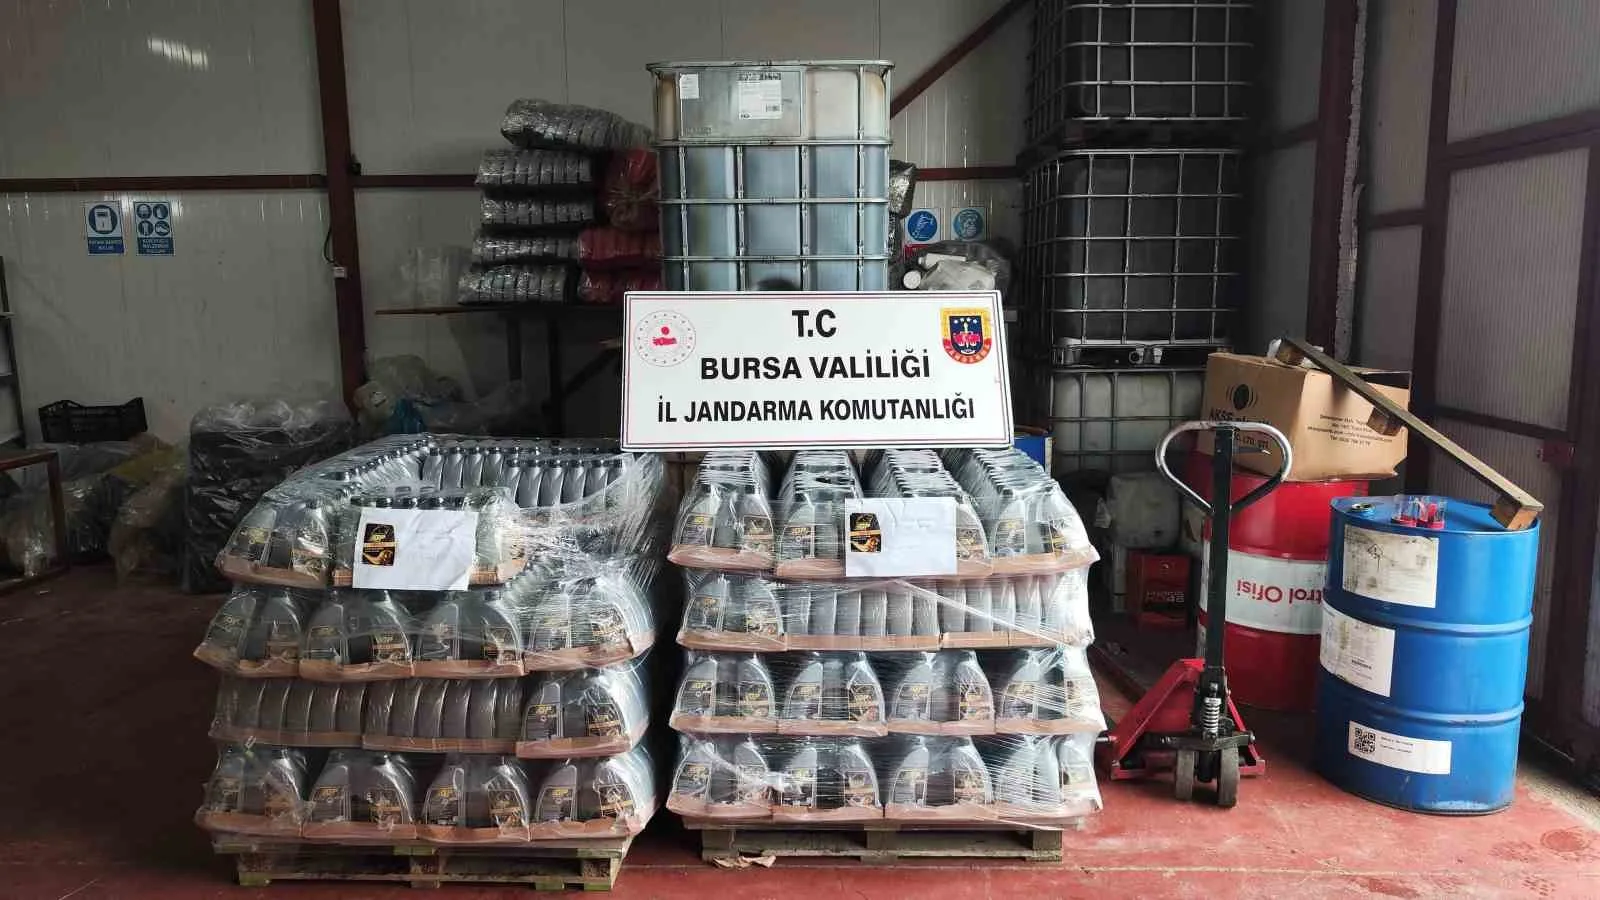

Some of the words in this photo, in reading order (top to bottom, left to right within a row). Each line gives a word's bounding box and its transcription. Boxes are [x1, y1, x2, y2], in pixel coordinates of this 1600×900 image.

[791, 308, 836, 338] T.C
[700, 355, 802, 381] BURSA
[808, 348, 931, 379] VALİLİĞİ
[657, 395, 678, 423] İL
[684, 399, 814, 423] JANDARMA
[819, 392, 976, 421] KOMUTANLIĞI
[1236, 579, 1283, 603] Ofisi
